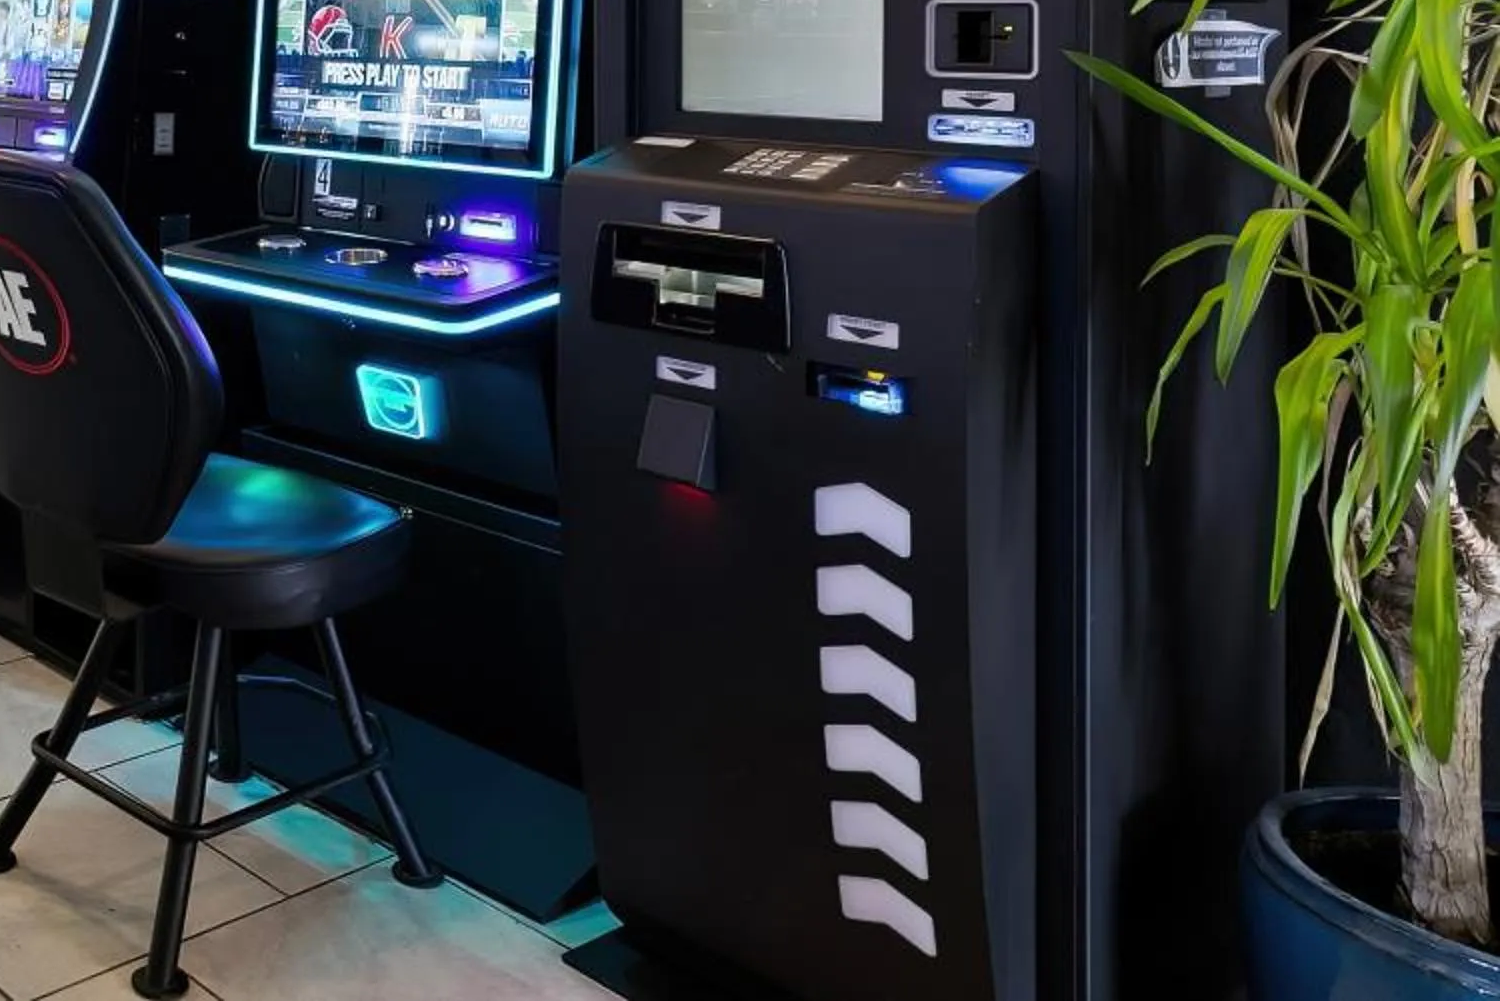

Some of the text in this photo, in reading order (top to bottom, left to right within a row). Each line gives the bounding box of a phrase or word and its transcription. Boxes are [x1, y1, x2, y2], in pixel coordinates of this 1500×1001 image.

[379, 14, 414, 60] K
[322, 61, 472, 91] PRESS PLAY TO START
